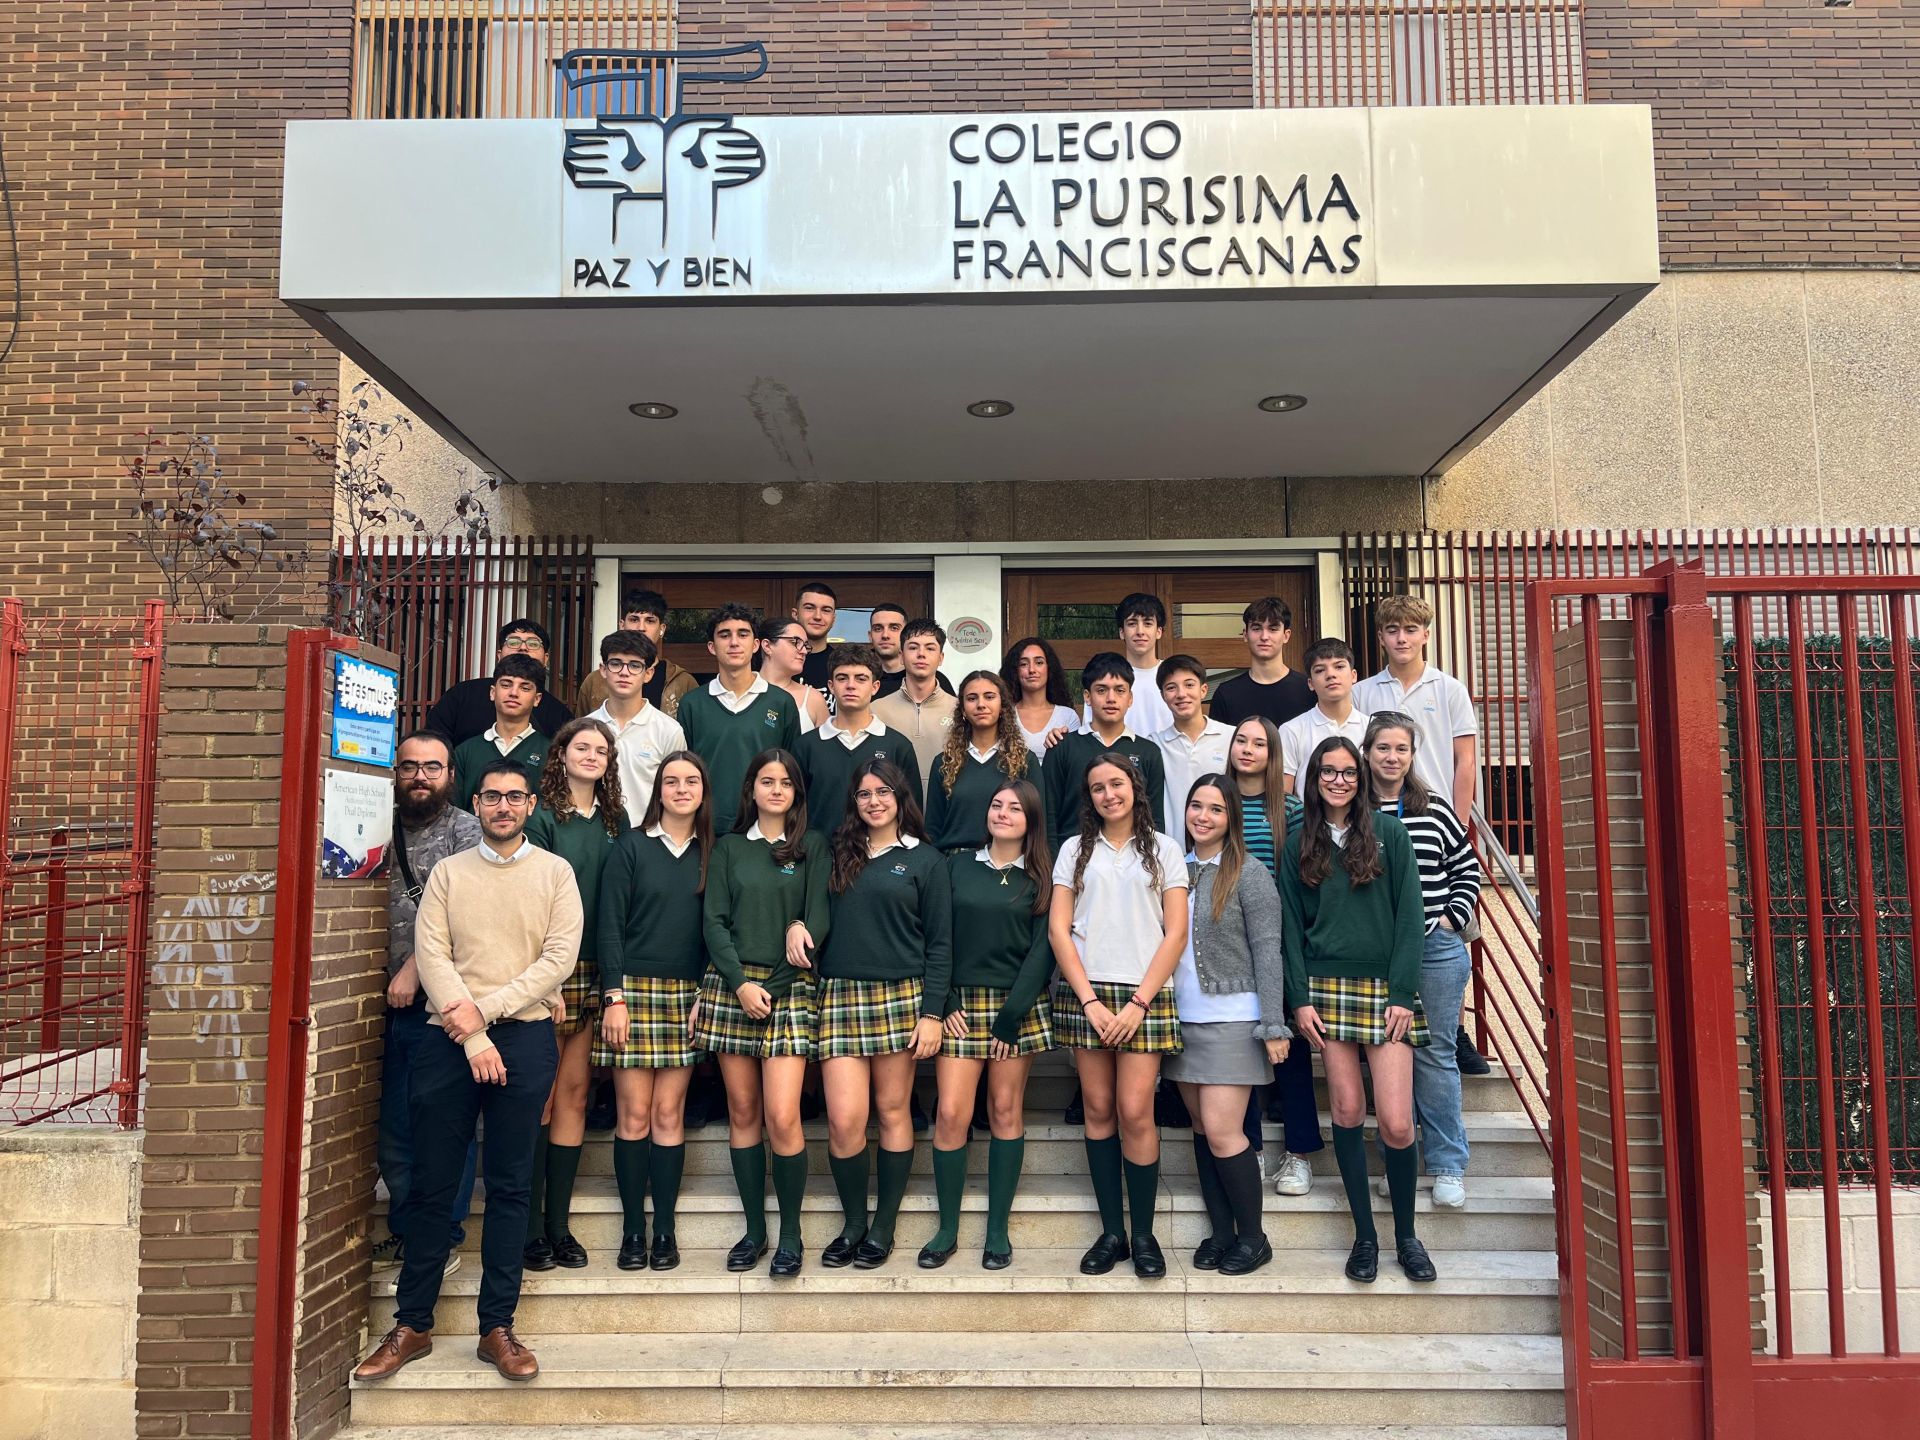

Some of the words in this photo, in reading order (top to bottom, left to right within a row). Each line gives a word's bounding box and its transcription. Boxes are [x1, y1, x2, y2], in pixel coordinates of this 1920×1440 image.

[950, 120, 1180, 164] COLEGIO
[954, 180, 1025, 228] LA
[1053, 174, 1360, 227] PURISIMA
[574, 259, 630, 288] PAZ
[648, 259, 669, 286] Y
[684, 258, 751, 287] BIEN
[954, 235, 1362, 279] FRANCISCANAS
